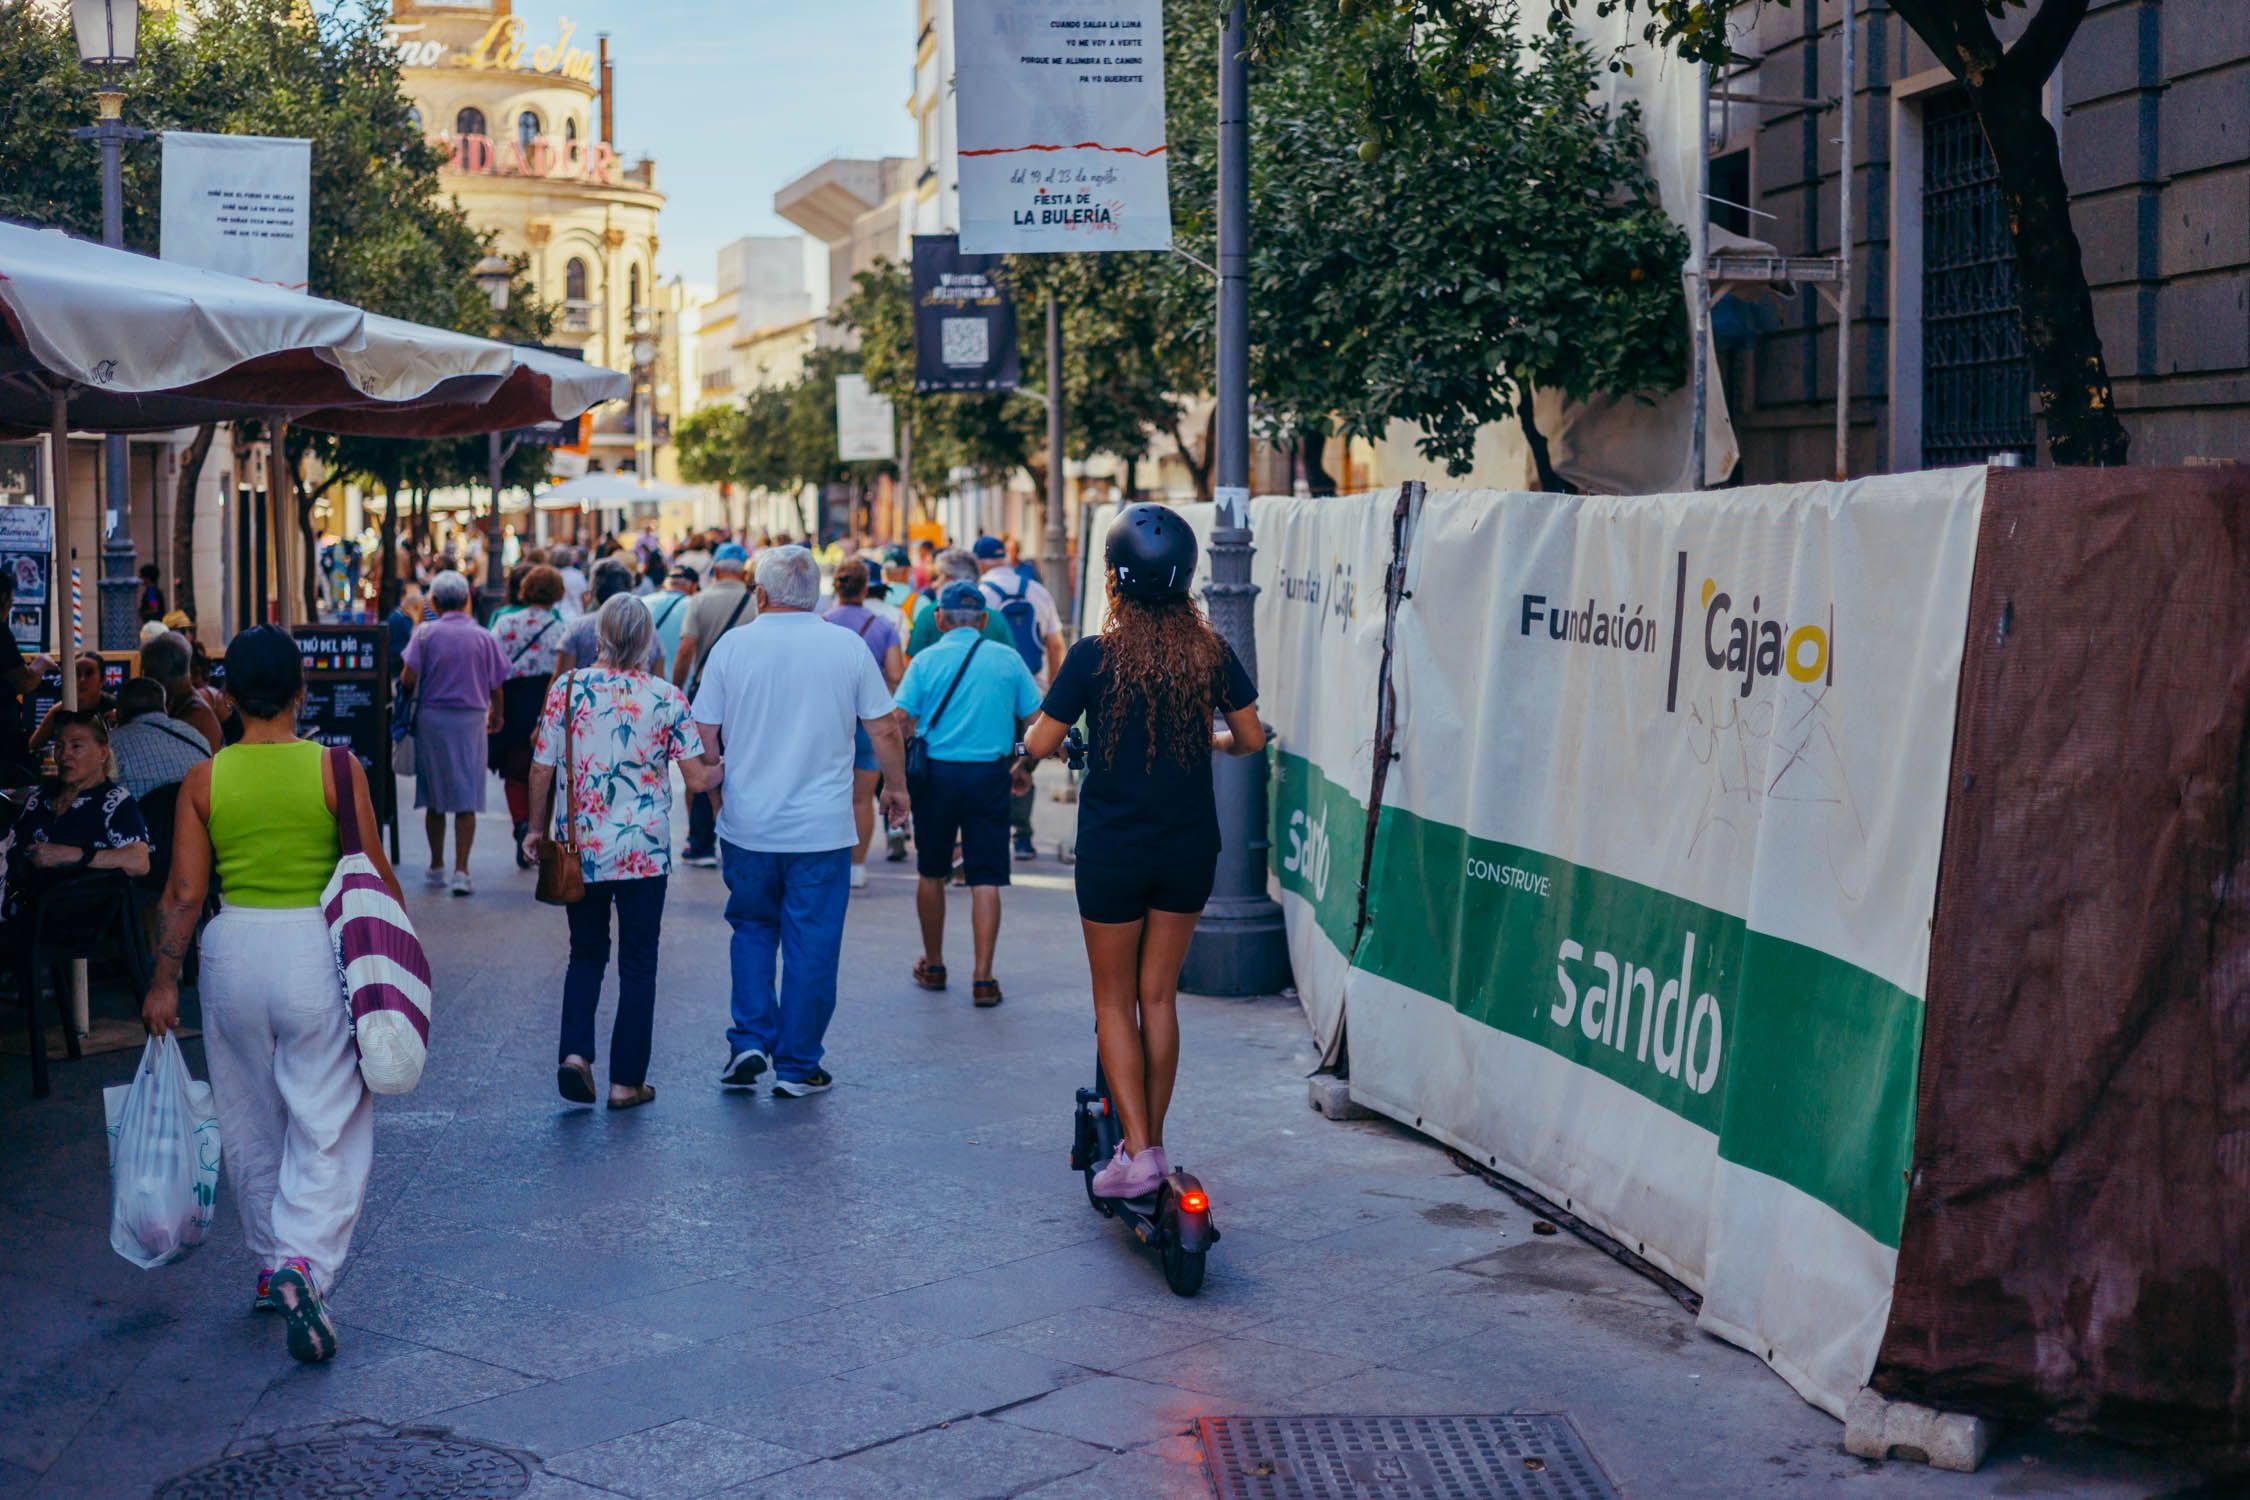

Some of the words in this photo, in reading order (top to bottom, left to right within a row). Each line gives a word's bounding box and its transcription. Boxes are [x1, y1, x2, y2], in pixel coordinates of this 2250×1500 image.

[1050, 20, 1080, 29] CUANDO
[1083, 20, 1107, 29] SALGA
[1109, 20, 1119, 29] LA
[1121, 20, 1142, 29] LUNA
[1066, 39, 1076, 47] YO
[1078, 39, 1089, 47] ME
[1092, 39, 1107, 47] VOY
[1109, 39, 1115, 47] A
[1118, 39, 1143, 47] VERTE
[1020, 56, 1049, 65] PORQUE
[1051, 57, 1063, 65] ME
[1065, 57, 1101, 65] ALUMBRA
[1103, 57, 1113, 65] EL
[1114, 57, 1143, 65] CAMINO
[1079, 75, 1089, 83] PA
[1091, 75, 1102, 83] YO
[1103, 75, 1144, 83] QUERERTE
[1033, 194, 1073, 206] FIESTA
[1076, 193, 1091, 205] DE
[1013, 209, 1036, 226] LA
[1041, 203, 1112, 225] BULERÍA
[1520, 593, 1657, 654] Fundación
[1549, 930, 1724, 1096] sando
